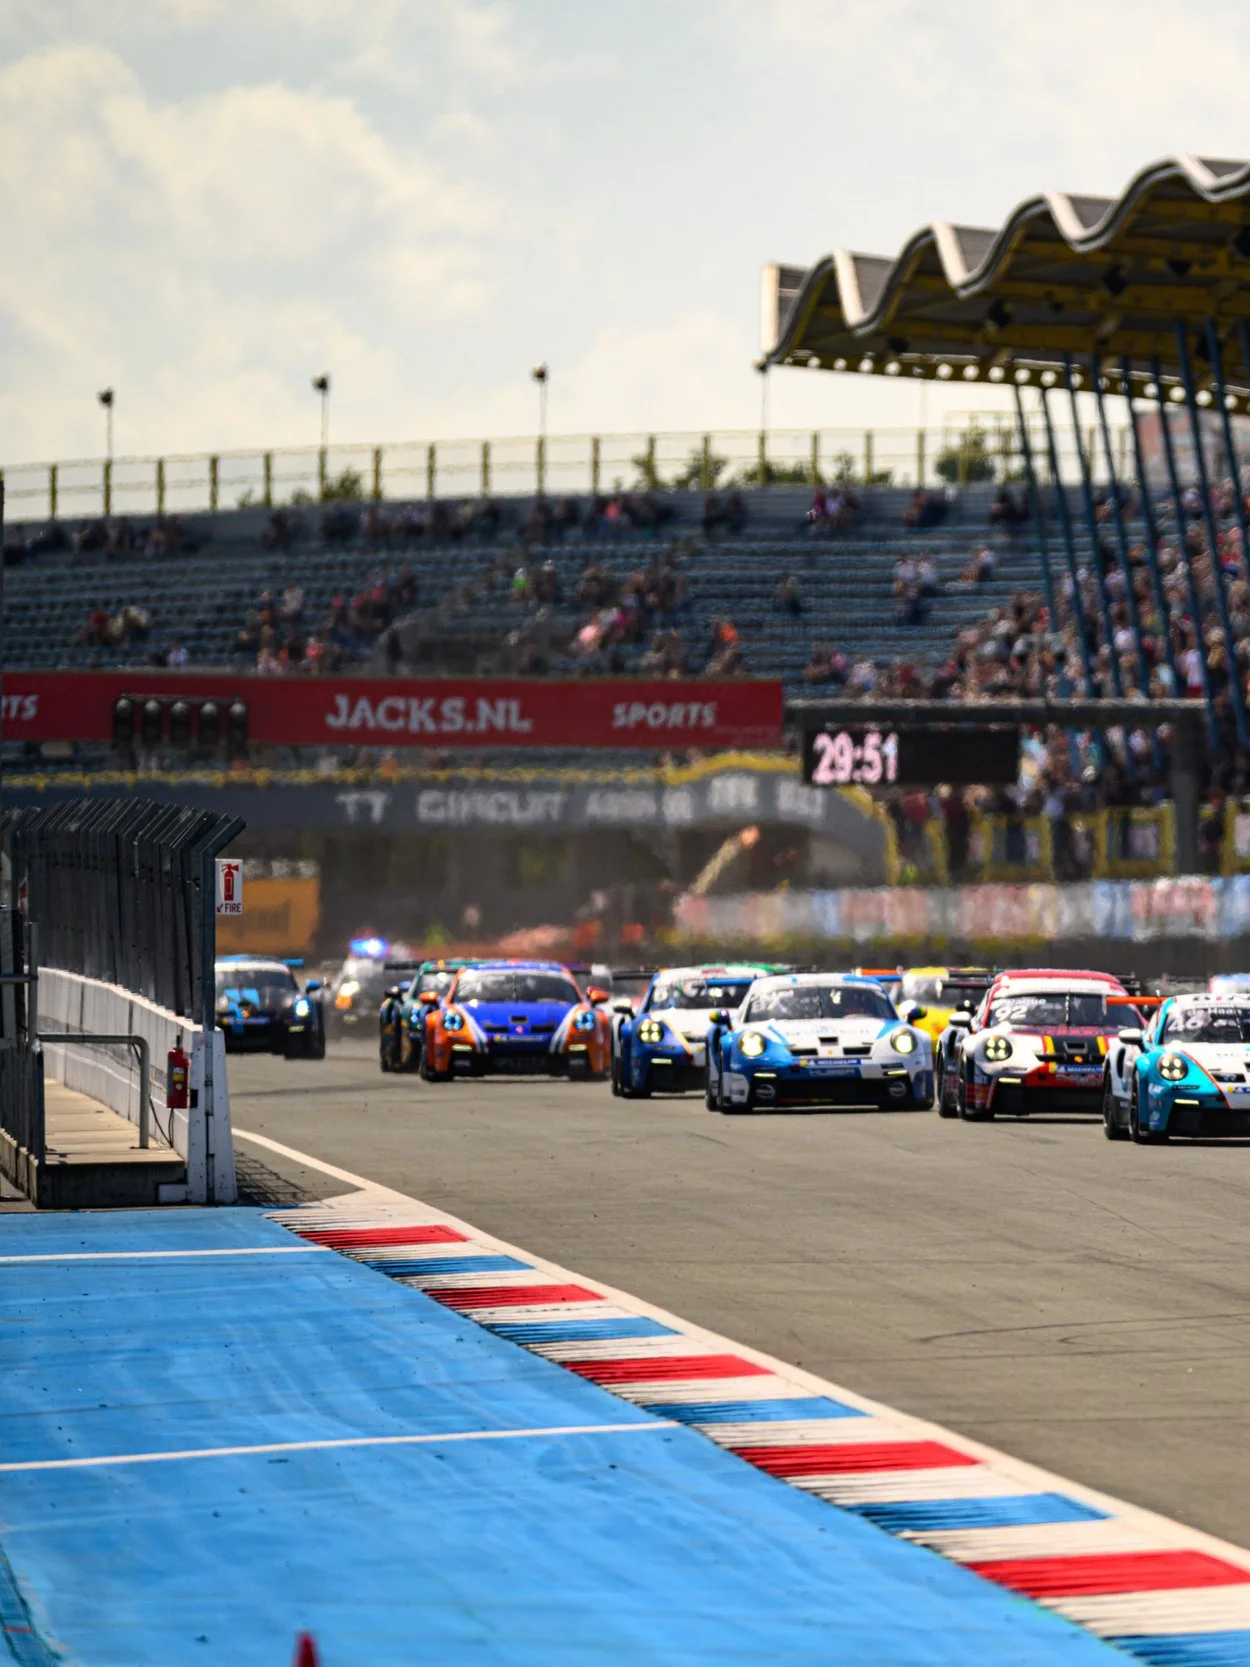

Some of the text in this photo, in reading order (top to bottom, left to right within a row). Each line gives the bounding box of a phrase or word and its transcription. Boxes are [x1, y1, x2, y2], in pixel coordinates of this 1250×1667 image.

[325, 693, 533, 733] JACKS.NL
[612, 702, 717, 729] SPORTS
[812, 731, 899, 783] 29:51
[225, 902, 242, 913] FIRE
[995, 1005, 1029, 1021] 92
